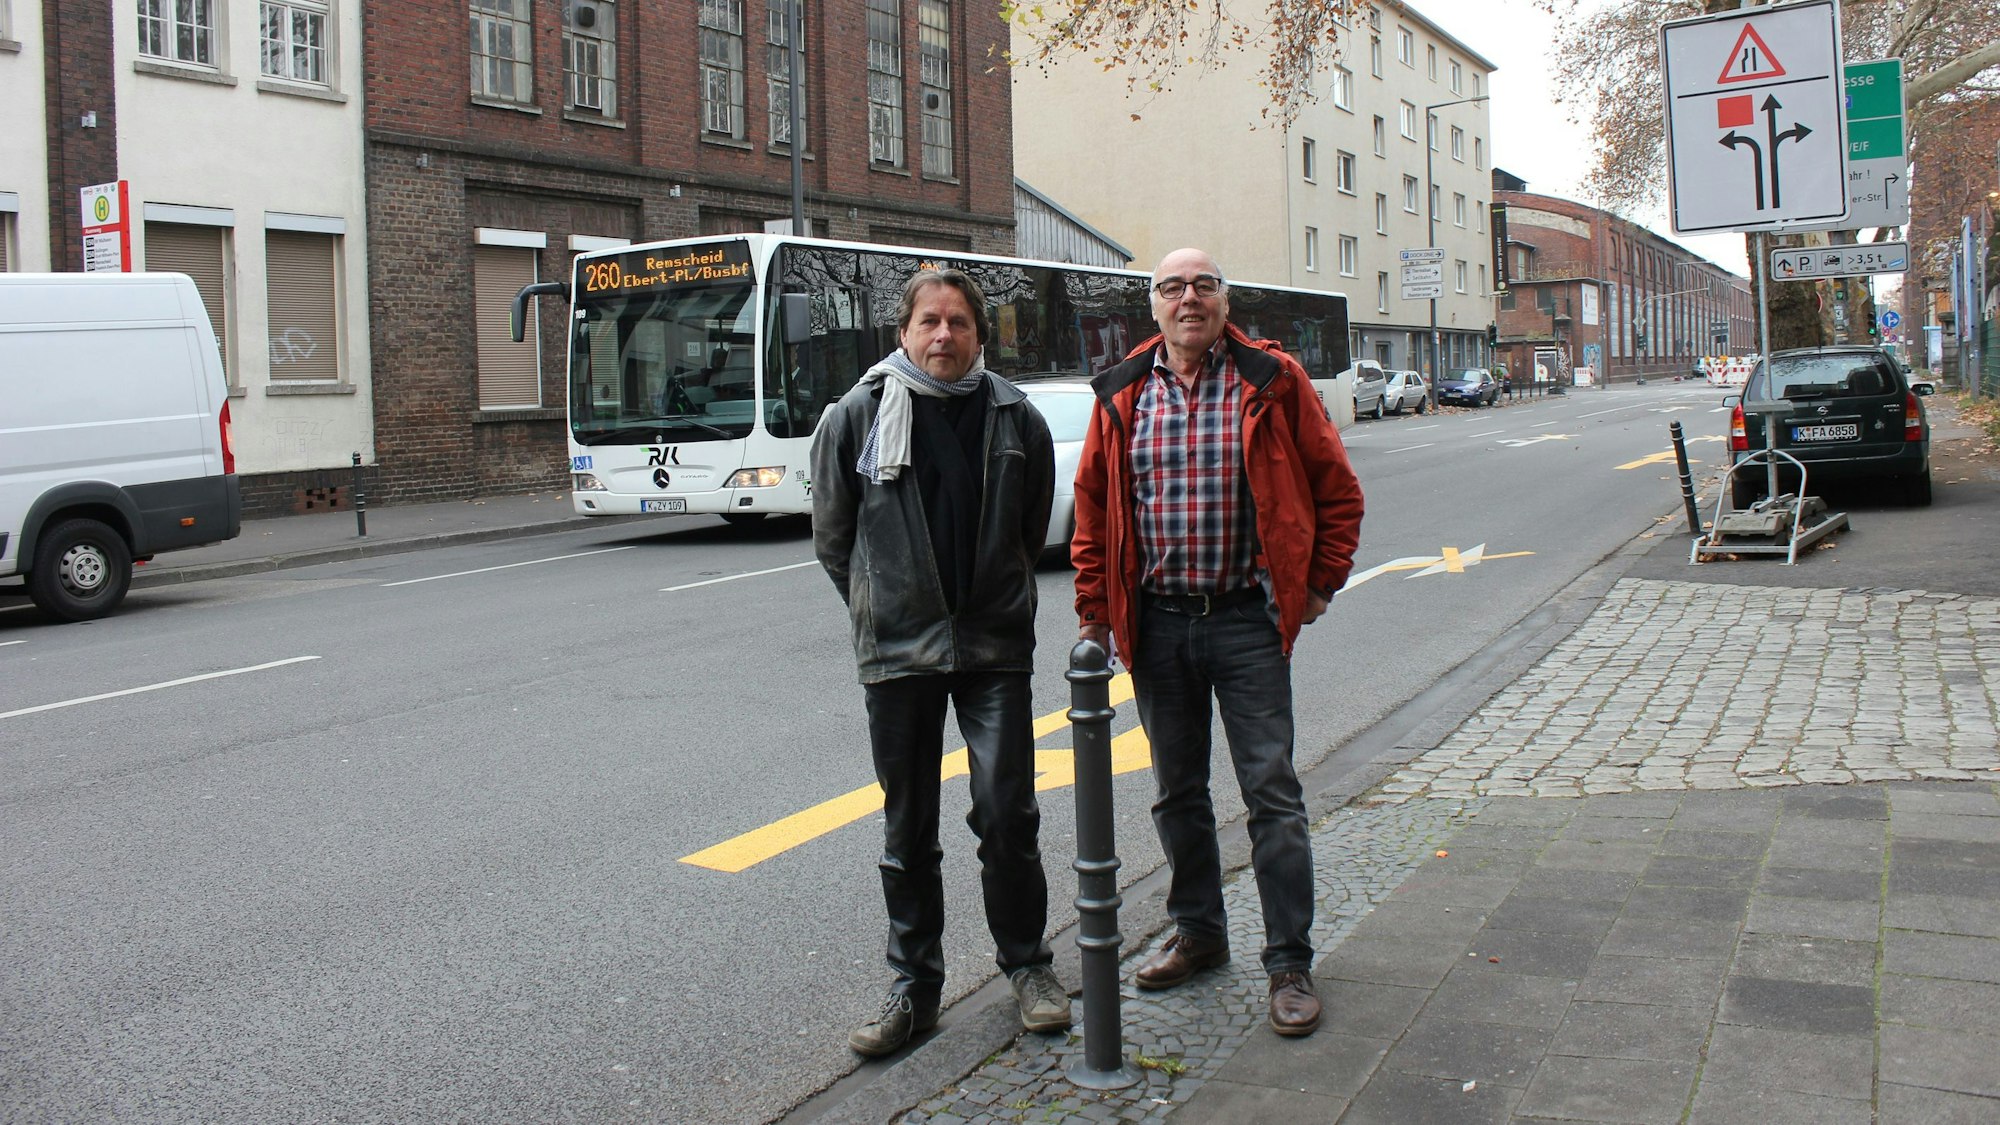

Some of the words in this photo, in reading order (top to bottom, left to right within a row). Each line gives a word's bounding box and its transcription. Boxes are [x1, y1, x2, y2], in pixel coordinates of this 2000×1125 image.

[1844, 75, 1875, 88] esse
[1849, 141, 1870, 153] /E/F
[1849, 171, 1863, 181] ahr
[1852, 193, 1884, 203] er-Str.
[646, 250, 723, 271] Remscheid
[585, 262, 621, 292] 260
[623, 262, 749, 288] Ebert-Pl./Busbf
[574, 308, 587, 320] 109
[1799, 429, 1806, 438] K
[1812, 427, 1826, 437] FA
[1828, 425, 1855, 436] 6858
[795, 470, 805, 480] 109
[647, 501, 653, 511] K
[669, 501, 682, 511] 109
